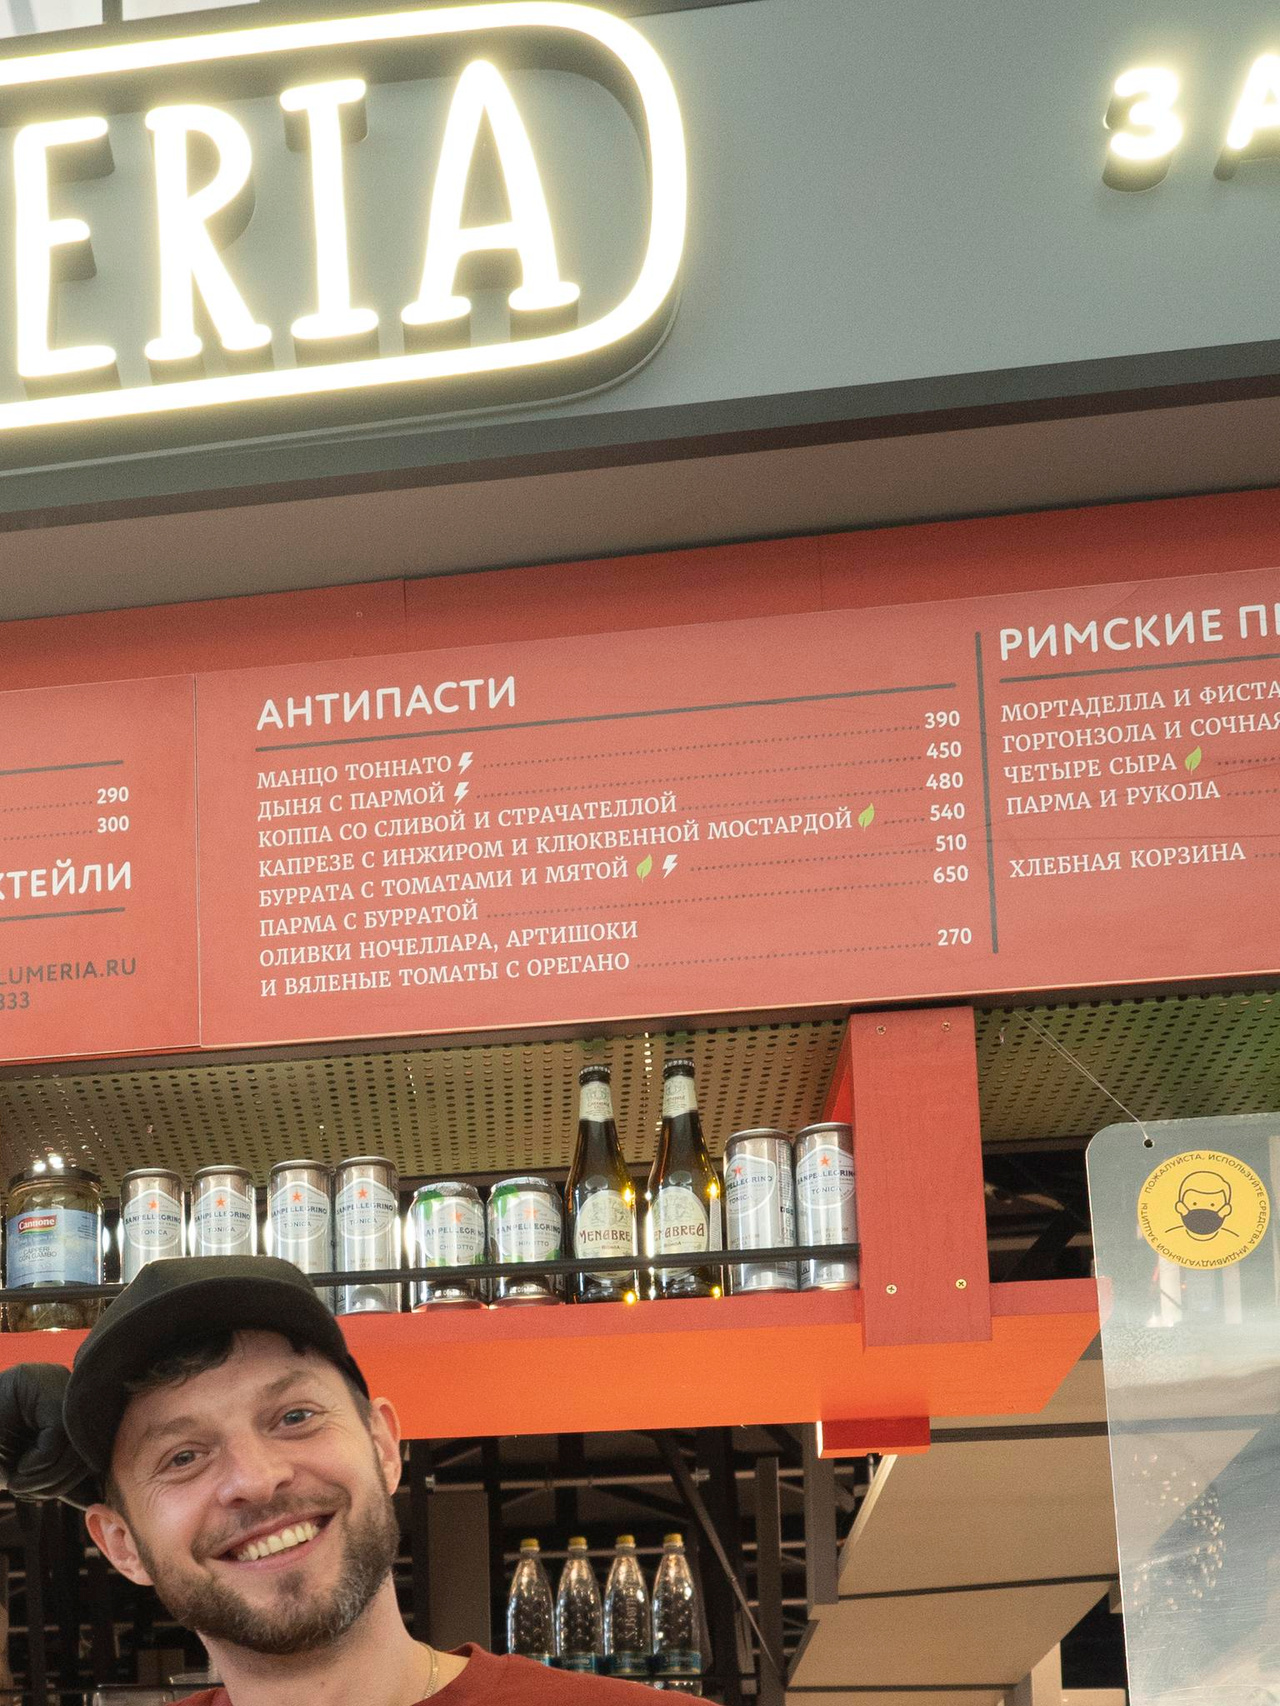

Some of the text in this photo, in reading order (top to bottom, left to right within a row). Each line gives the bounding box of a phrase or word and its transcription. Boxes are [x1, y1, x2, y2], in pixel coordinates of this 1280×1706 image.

[999, 602, 1280, 661] РИМСКИЕ П
[256, 675, 515, 731] АНТИПАСТИ
[1001, 691, 1165, 722] МОРТАДЕЛЛА
[1173, 688, 1191, 707] И
[257, 710, 960, 789] МАНЦО ТОННАТО 390
[1002, 723, 1156, 753] ГОРГОНЗОЛА
[1164, 720, 1182, 739] И
[257, 740, 962, 822] ДЫНЯ С ПАРМОЙ 450
[1003, 752, 1177, 783] ЧЕТЫРЕ СЫРА
[96, 786, 129, 804] 290
[258, 771, 963, 848] КОППА СО СЛИВОЙ И СТРАЧАТЕЛЛОЙ 480
[1006, 780, 1220, 815] ПАРМА И РУКОЛА
[97, 815, 129, 833] 300
[259, 802, 965, 878] КАПРЕЗЕ С ИНЖИРОМ И КЛЮКВЕННОЙ МОСТАРДОЙ 540
[259, 833, 967, 907] БУРРАТА С ТОМАТАМИ И МЯТОЙ 510
[1009, 842, 1246, 878] ХЛЕБНАЯ КОРЗИНА
[259, 864, 969, 937] ПАРМА С БУРРАТОЙ 650
[259, 920, 638, 967] ОЛИВКИ НОЧЕЛЛАРА, АРТИШОКИ
[260, 927, 972, 997] И ВЯЛЕНЫЕ ТОМАТЫ С ОРЕГАНО 270
[1208, 1154, 1264, 1198] ИСПОЛЬЗУЙТЕ
[18, 1216, 55, 1230] Cannone
[1141, 1202, 1159, 1243] ЗАЩИТЫ
[1248, 1200, 1267, 1245] СРЕДСТВА
[1156, 1243, 1249, 1267] ИНДИВИДУАЛЬНОЙ
